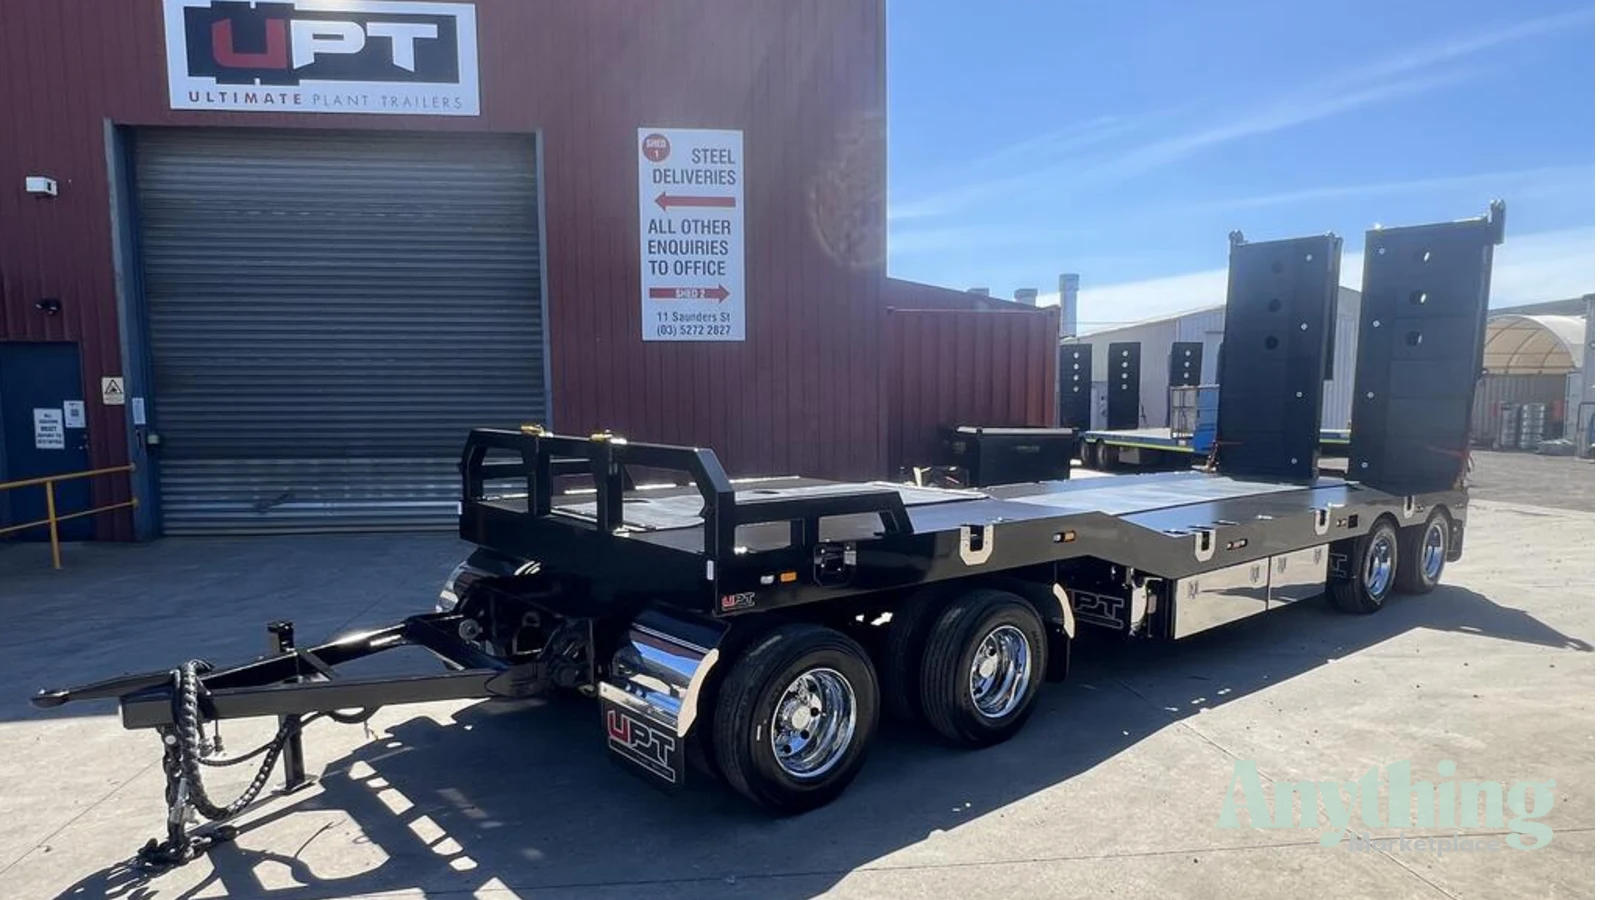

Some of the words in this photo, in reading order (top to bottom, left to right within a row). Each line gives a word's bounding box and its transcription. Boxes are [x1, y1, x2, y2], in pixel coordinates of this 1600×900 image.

[212, 18, 438, 72] UPT
[188, 91, 302, 105] ULTIMATE
[312, 93, 369, 107] PLANT
[381, 95, 463, 109] TRAILERS
[646, 138, 667, 148] SHED
[691, 148, 736, 165] STEEL
[652, 168, 737, 185] DELIVERIES
[648, 219, 676, 235] ALL
[681, 219, 732, 235] OTHER
[648, 239, 729, 256] ENQUIRIES
[648, 260, 669, 276] TO
[673, 260, 726, 276] OFFICE
[675, 288, 699, 299] SHED
[699, 288, 706, 299] 2
[657, 312, 668, 322] 11
[672, 311, 718, 322] Saunders
[719, 312, 731, 323] St
[657, 324, 677, 337] (03)
[680, 324, 705, 336] 5272
[721, 592, 755, 608] UPT
[607, 710, 675, 767] UPT
